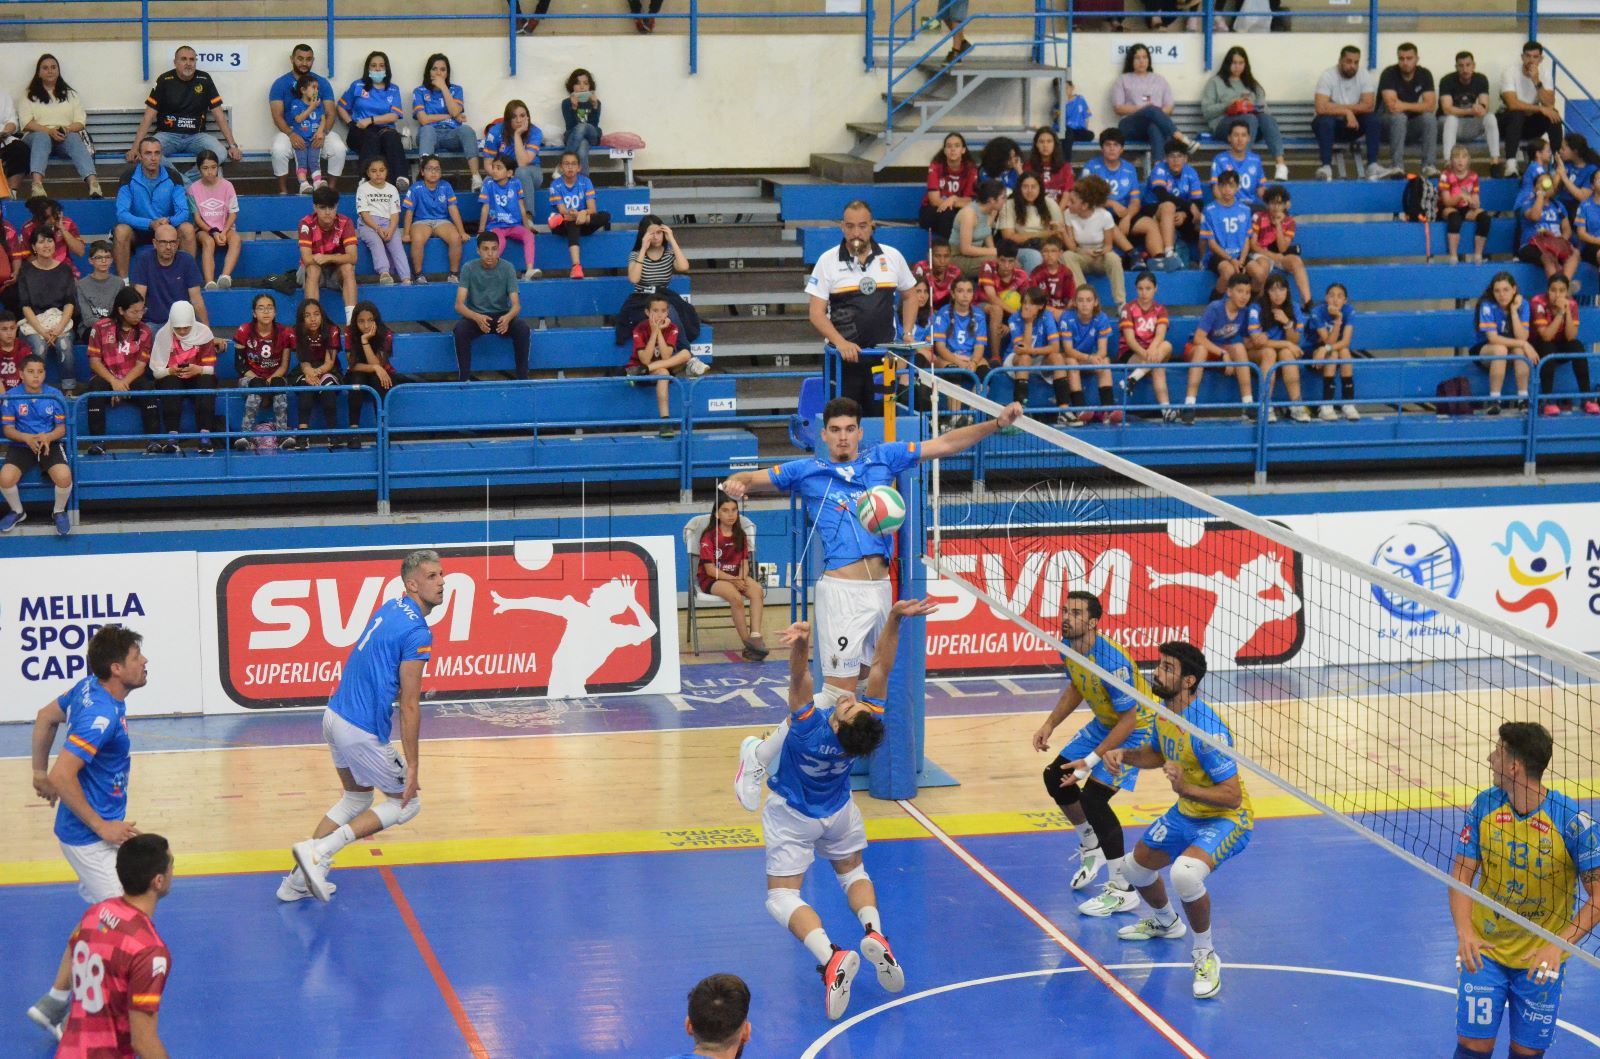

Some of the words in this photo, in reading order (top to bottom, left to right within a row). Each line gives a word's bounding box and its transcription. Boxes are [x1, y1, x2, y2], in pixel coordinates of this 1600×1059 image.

[1168, 45, 1178, 59] 4
[230, 53, 241, 67] 3
[627, 149, 633, 157] 6
[563, 195, 580, 208] 90
[643, 206, 649, 214] 5
[1223, 218, 1238, 233] 15
[1137, 317, 1155, 332] 24
[957, 330, 966, 344] 5
[260, 344, 272, 359] 8
[704, 346, 711, 354] 2
[0, 361, 17, 376] 28
[727, 401, 733, 409] 1
[19, 592, 146, 622] MELILLA
[358, 616, 382, 651] 1
[837, 636, 848, 651] 9
[926, 632, 1008, 656] UPERLIGA
[435, 652, 537, 678] MASCULINA
[244, 660, 342, 686] SUPERLIGA
[1079, 673, 1087, 693] 7
[1162, 734, 1176, 760] 18
[394, 758, 404, 772] 1
[1507, 840, 1529, 870] 13
[99, 906, 120, 929] UNAI
[72, 939, 105, 1014] 88
[1465, 996, 1493, 1025] 13
[1522, 1009, 1553, 1025] HPS
